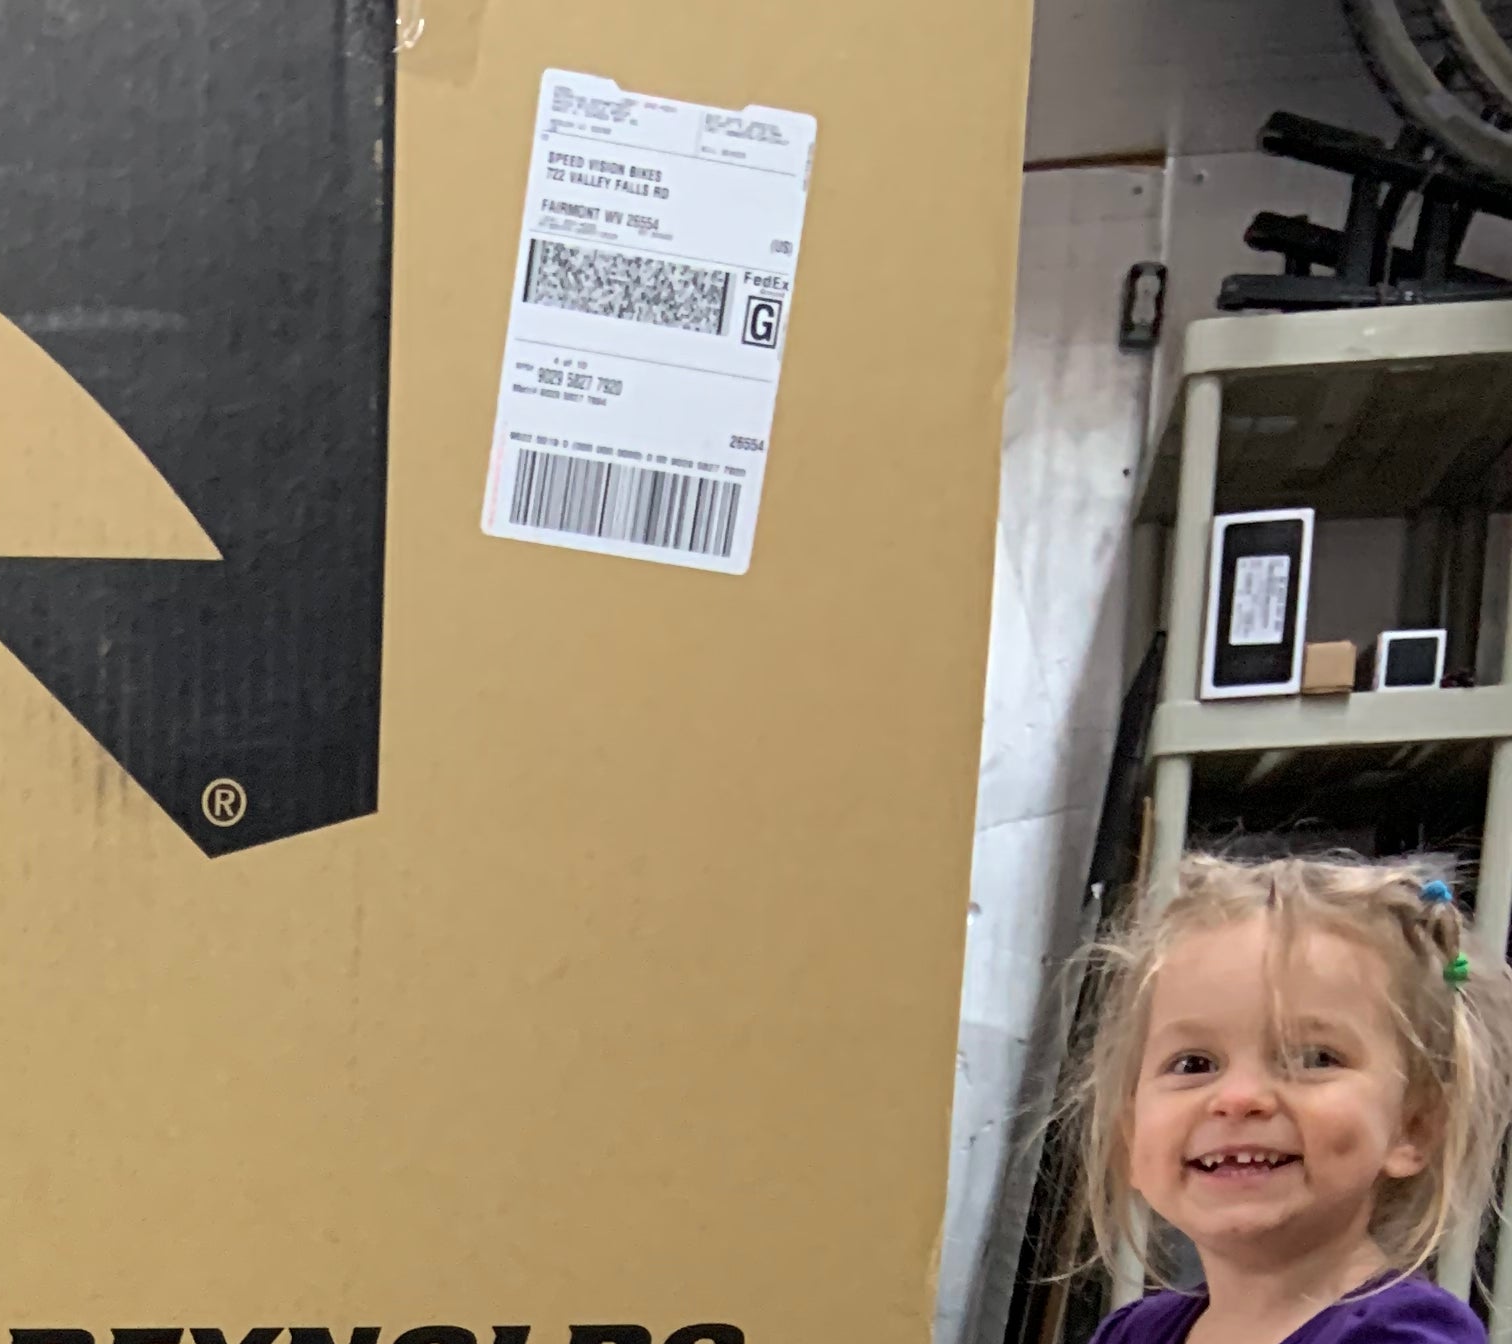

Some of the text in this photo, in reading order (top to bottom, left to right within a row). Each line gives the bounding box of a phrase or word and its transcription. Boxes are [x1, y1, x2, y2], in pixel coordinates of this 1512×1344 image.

[547, 151, 662, 183] SPEED VISION BIKES
[569, 170, 612, 191] VALLEY
[614, 179, 649, 197] FALLS
[541, 198, 601, 220] FAIRMONT
[743, 271, 790, 292] FedEx
[749, 303, 777, 343] G
